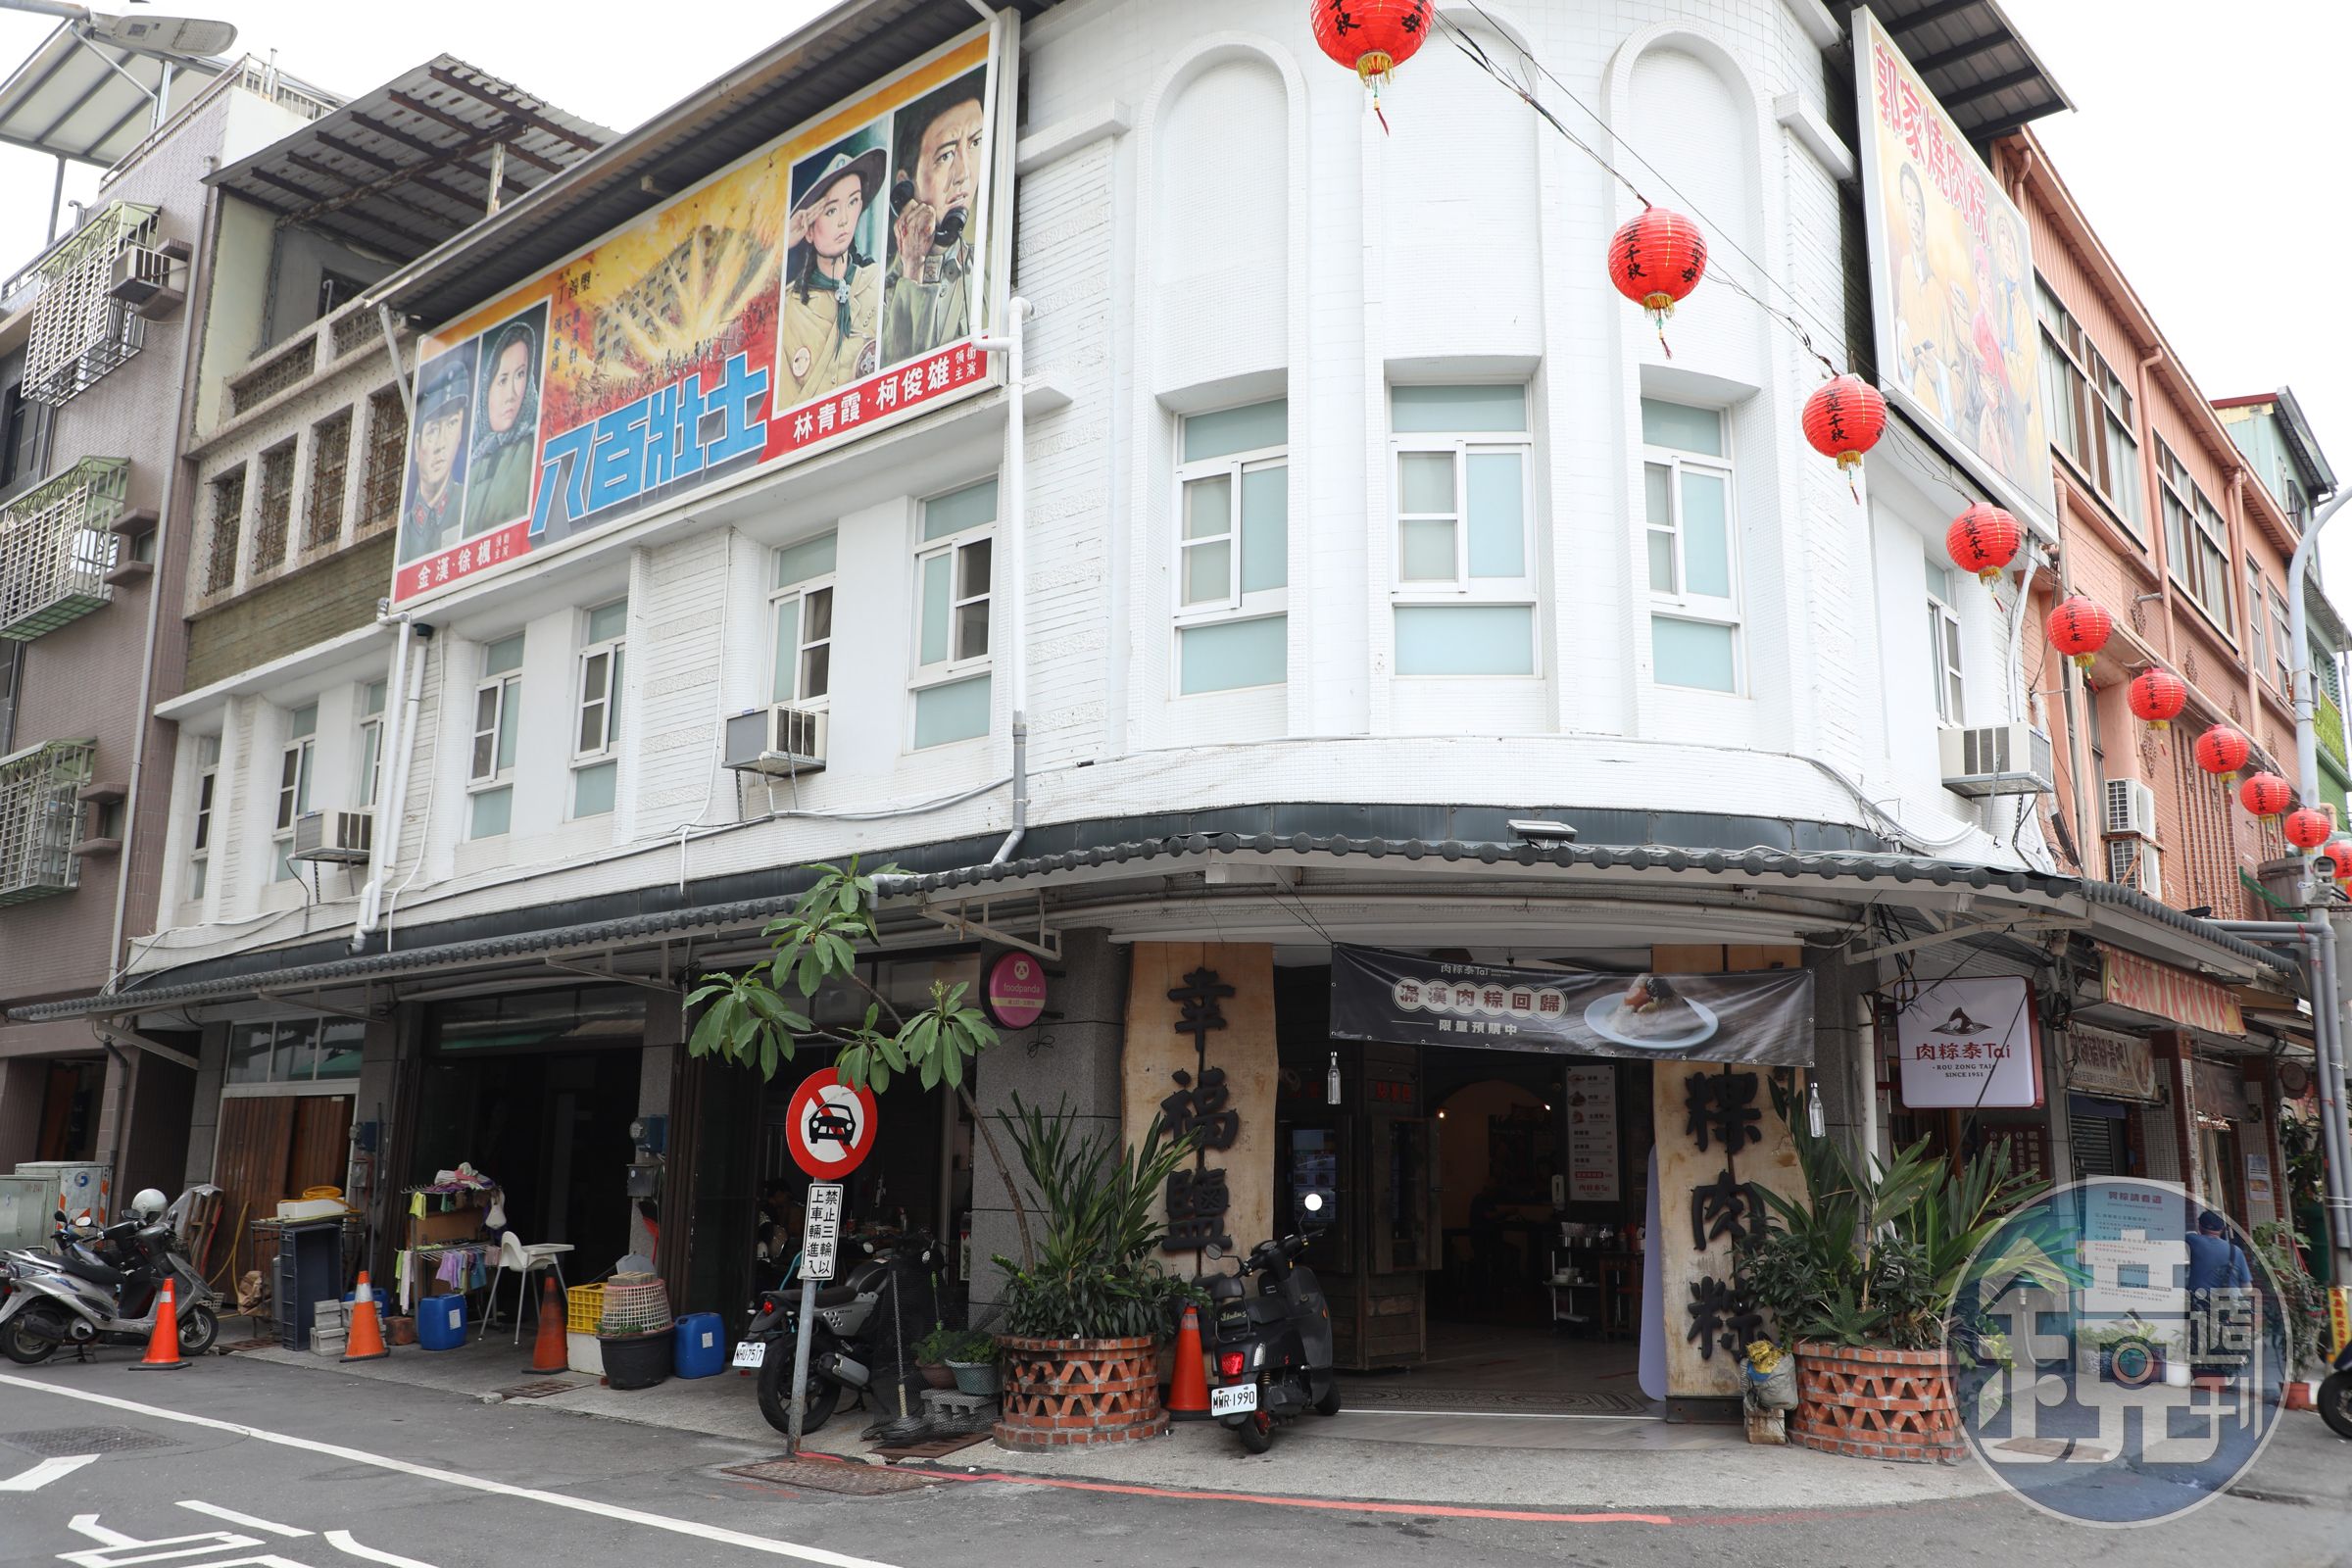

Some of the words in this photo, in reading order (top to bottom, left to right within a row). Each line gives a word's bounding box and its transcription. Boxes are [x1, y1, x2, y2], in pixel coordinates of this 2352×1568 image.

[1875, 41, 1990, 249] 郭家燒肉粽
[527, 351, 769, 538] 八百壯士
[1004, 982, 1040, 994] foodpanda
[1399, 984, 1560, 1012] 滿漢肉粽回歸
[1439, 1019, 1518, 1035] 限量預購中
[807, 1189, 824, 1274] 上車輛進入
[818, 1190, 838, 1274] 禁止三輪以
